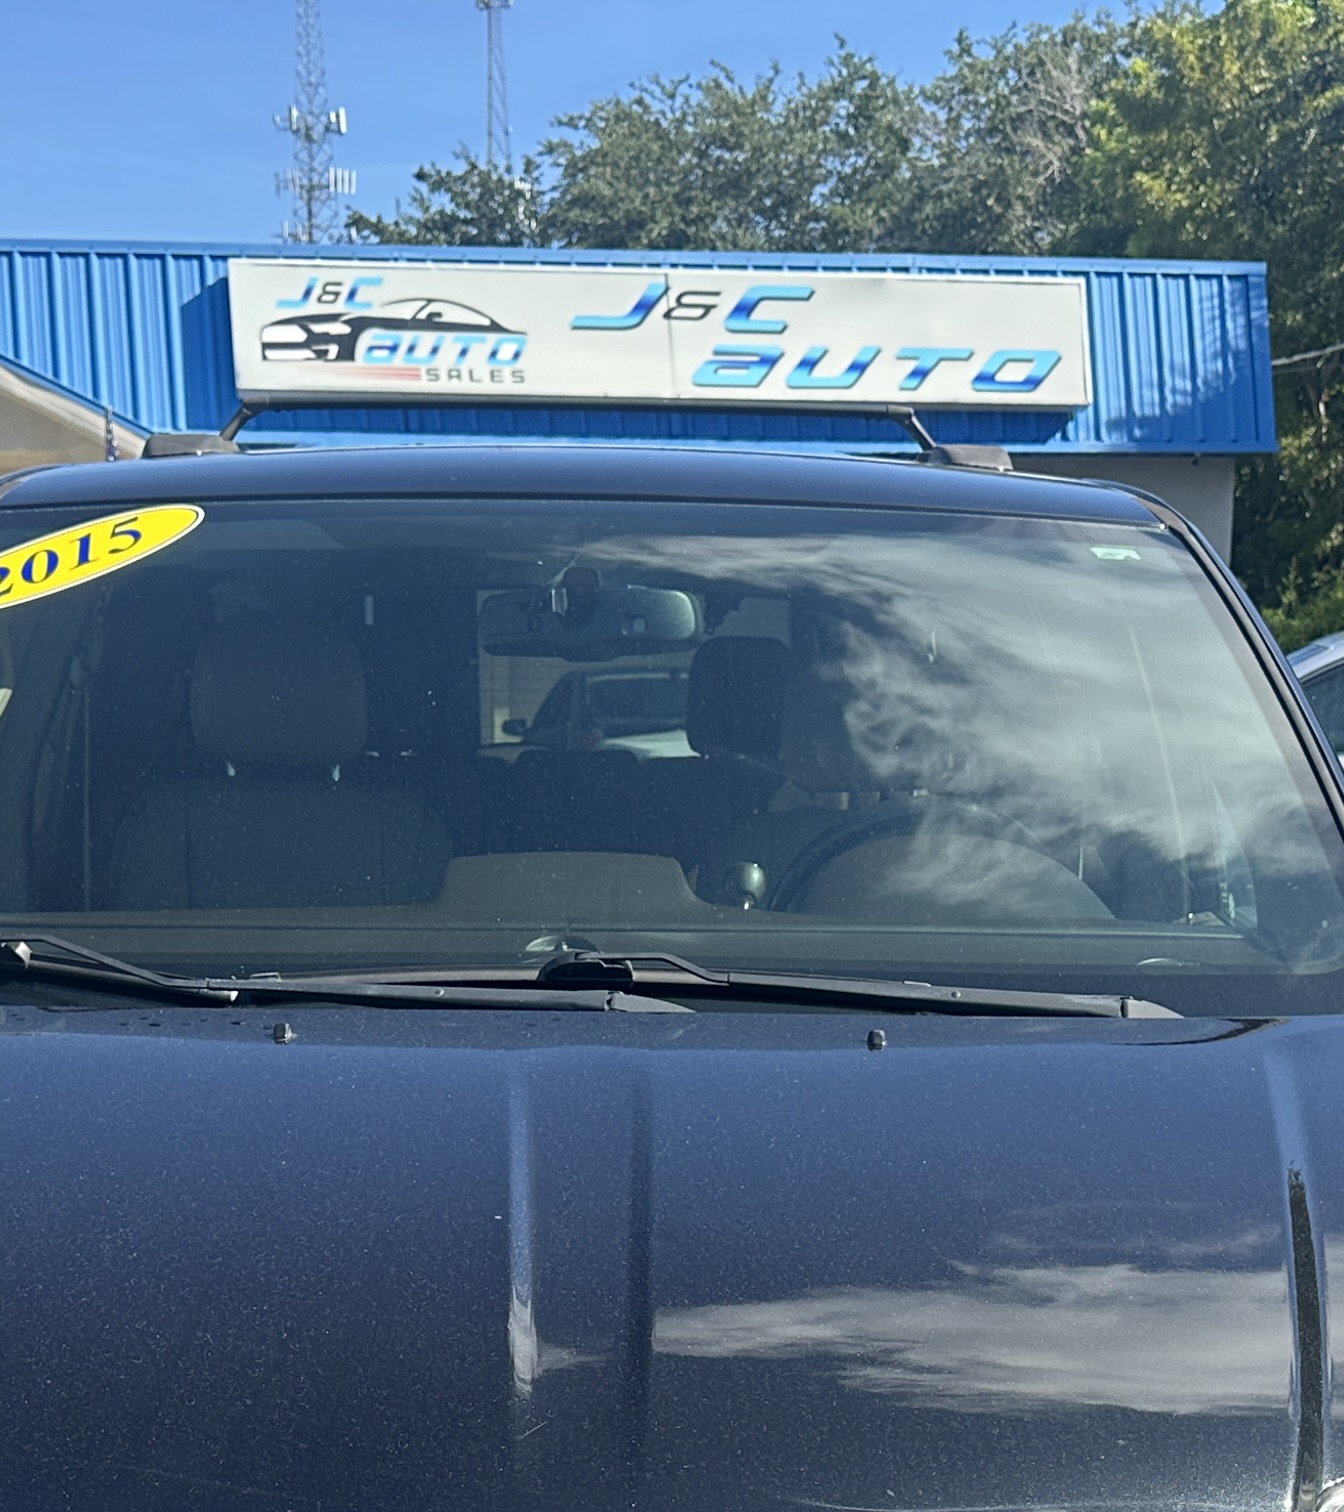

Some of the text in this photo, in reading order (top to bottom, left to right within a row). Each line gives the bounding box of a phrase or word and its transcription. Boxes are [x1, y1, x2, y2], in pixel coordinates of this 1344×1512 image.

[275, 276, 384, 309] J&C
[570, 282, 815, 334] J&C
[425, 368, 526, 384] SALES
